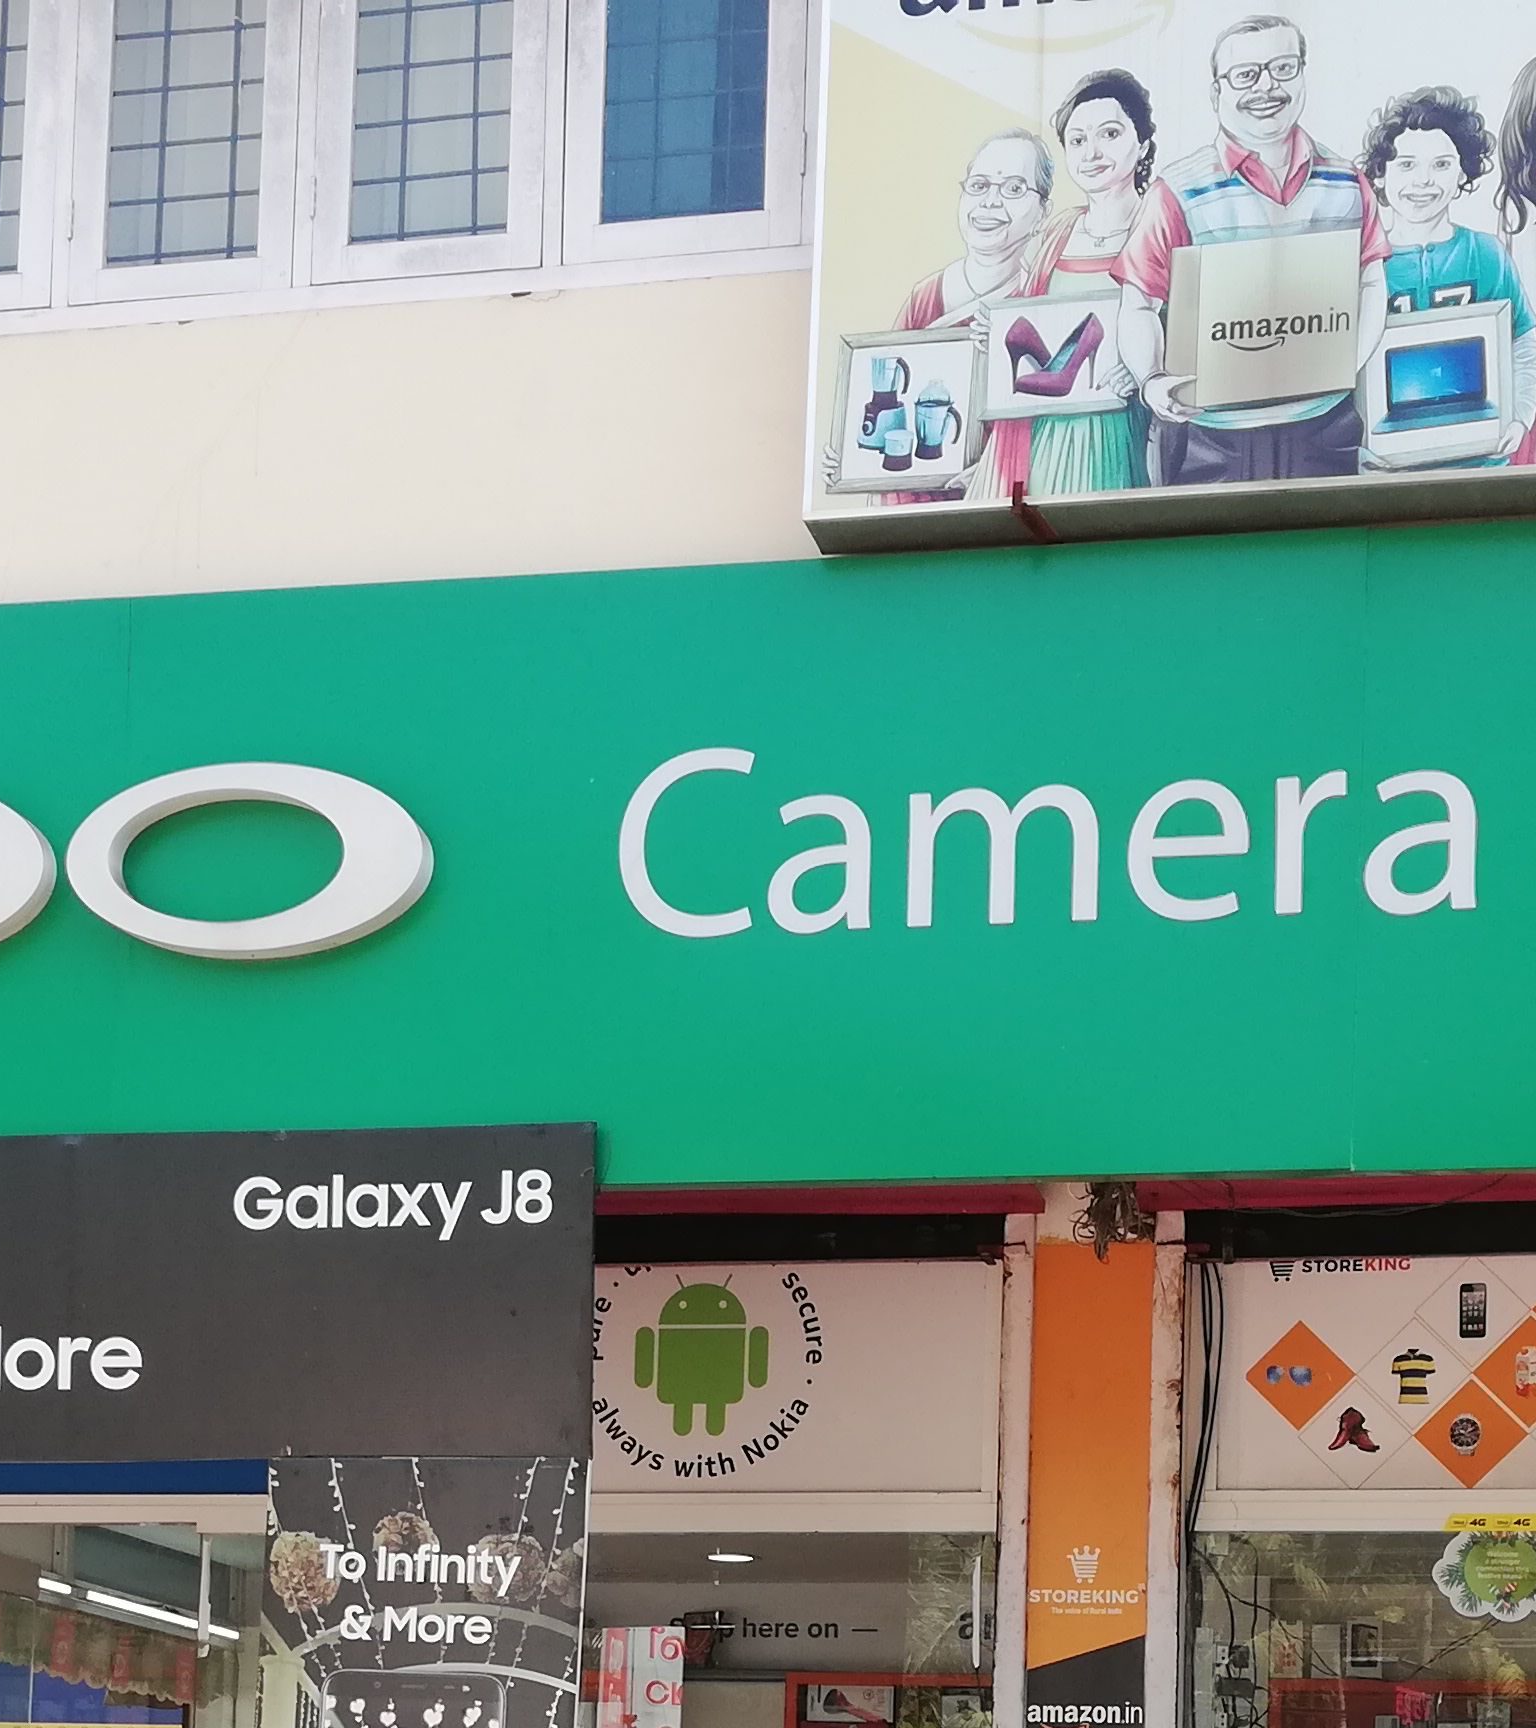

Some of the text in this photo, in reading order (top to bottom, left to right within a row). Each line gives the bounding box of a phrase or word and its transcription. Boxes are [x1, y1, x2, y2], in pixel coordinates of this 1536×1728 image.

[1211, 306, 1351, 343] amazon.in
[615, 747, 1478, 940] Camera
[231, 1168, 555, 1241] Galaxy J8
[1301, 1256, 1411, 1275] STOREKING
[781, 1272, 822, 1365] secure
[592, 1397, 810, 1478] always with Nokia
[319, 1543, 523, 1598] To Infinity
[1028, 1589, 1140, 1604] STOREKING
[340, 1604, 494, 1646] & More
[742, 1616, 839, 1639] here on
[1027, 1701, 1144, 1725] amazon.in
